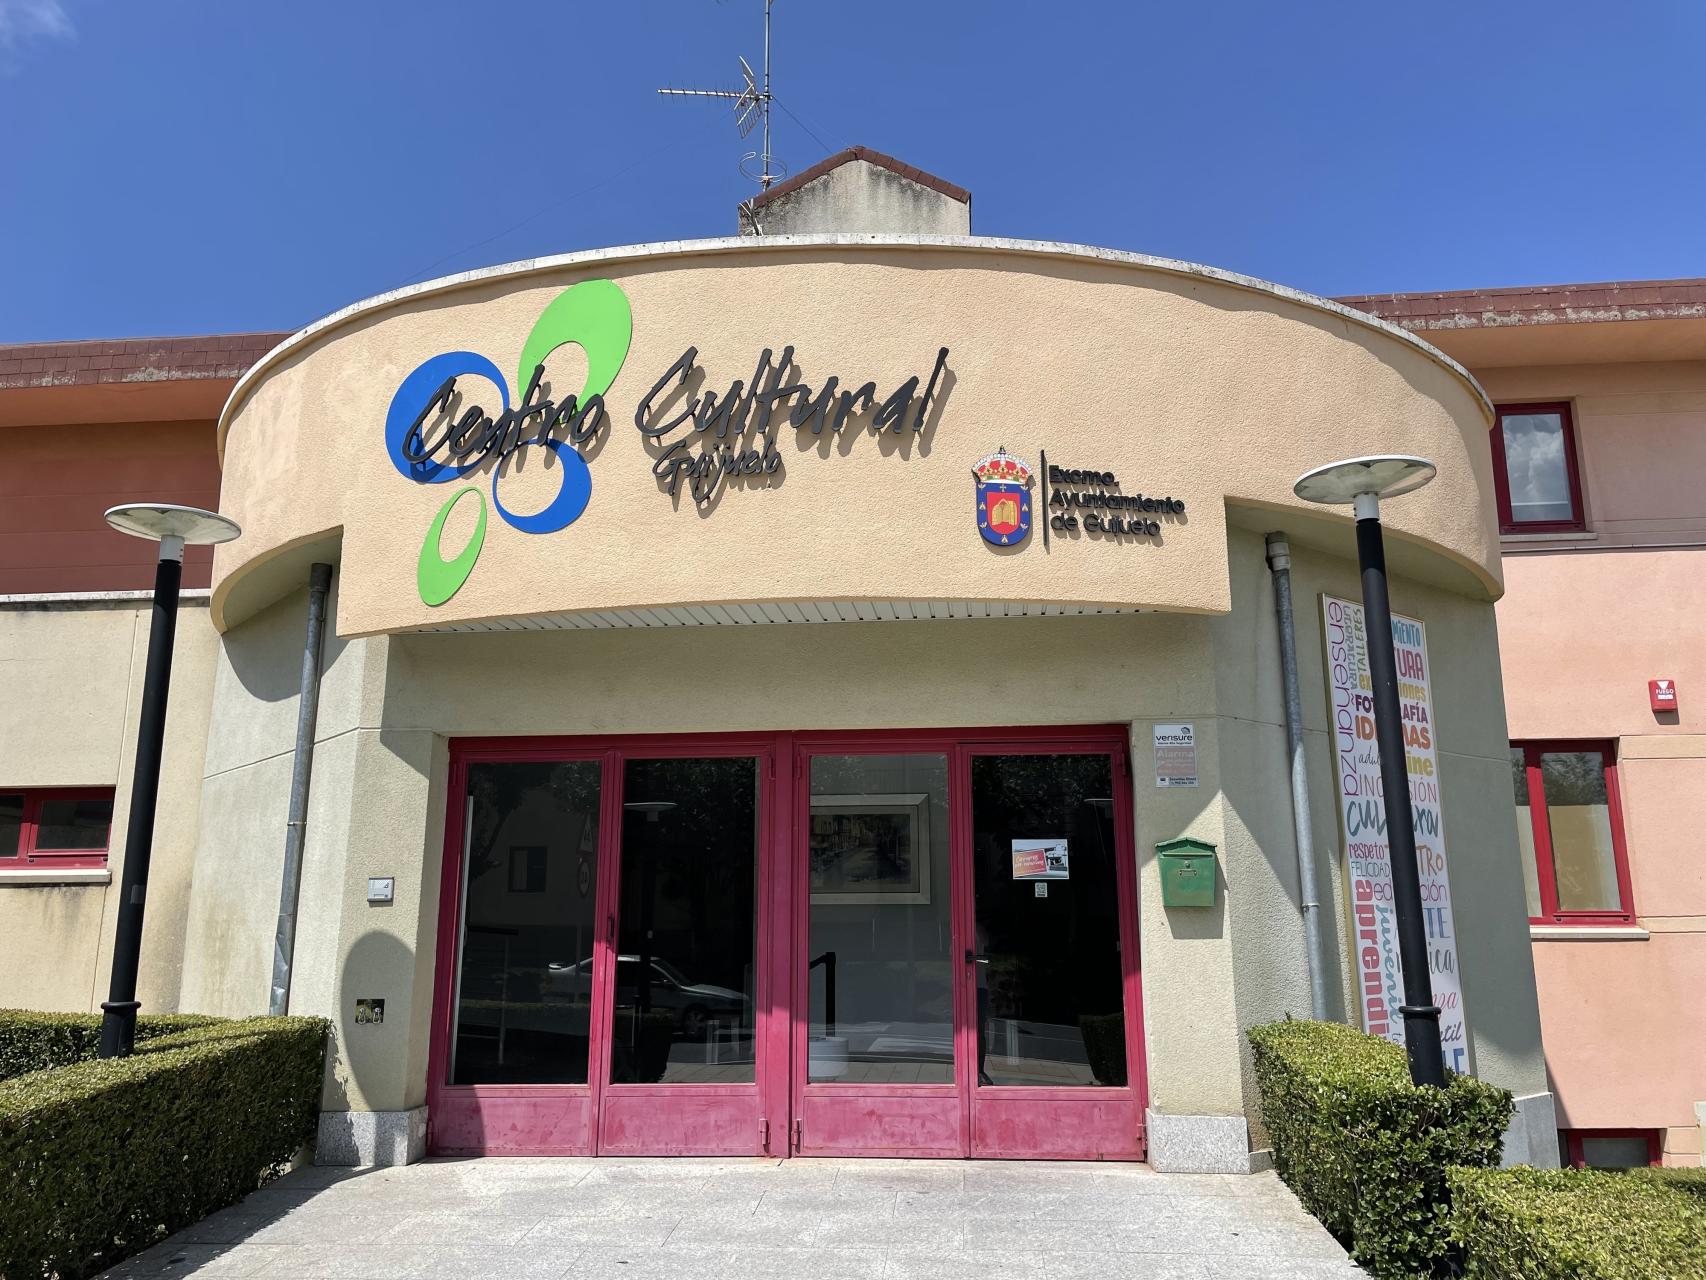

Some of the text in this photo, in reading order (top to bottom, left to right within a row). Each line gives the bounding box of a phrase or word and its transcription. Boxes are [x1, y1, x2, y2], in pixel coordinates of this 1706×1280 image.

[402, 346, 949, 463] Centro Cultural
[652, 436, 783, 503] Guijuelo
[1049, 465, 1120, 487] Excmo.
[1049, 488, 1186, 515] Ayuntamiento
[1050, 513, 1161, 537] de Guijuelo
[1353, 608, 1367, 673] TALLERES
[1328, 601, 1360, 797] enseñanza
[1406, 751, 1434, 777] ine
[1348, 841, 1385, 861] respeto
[1351, 861, 1391, 878] FELICIDAD
[1354, 879, 1390, 1039] aprendi
